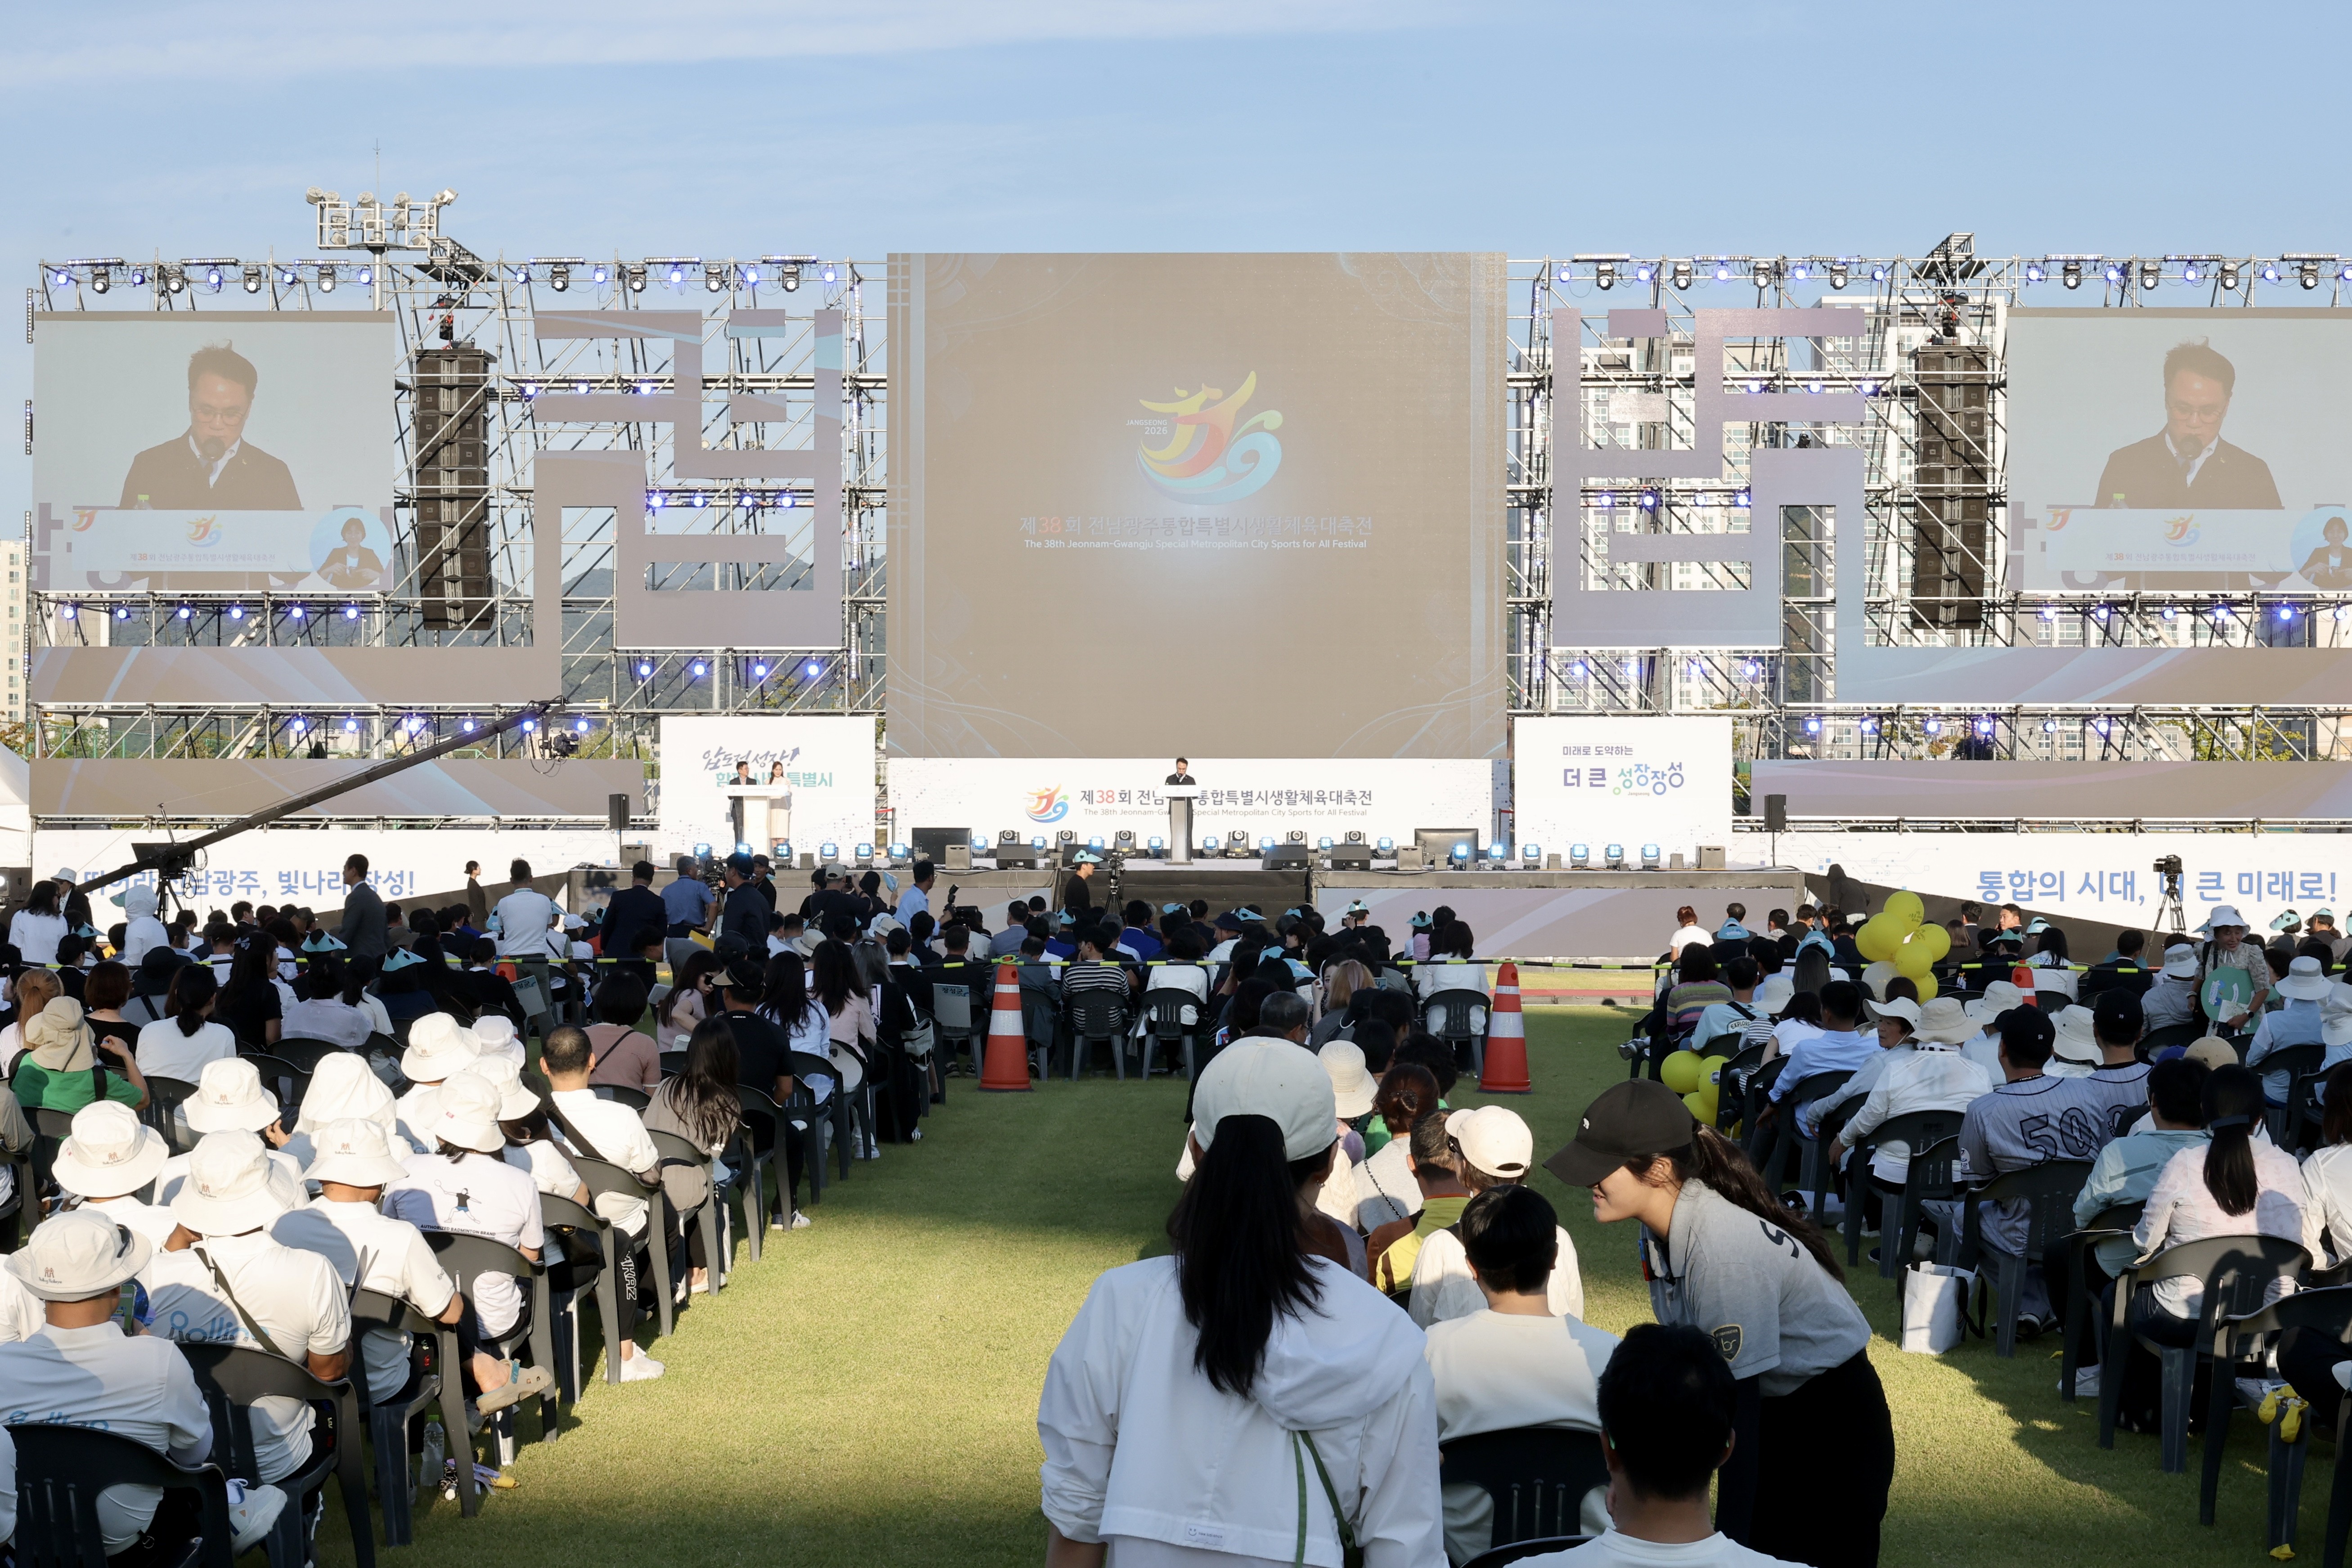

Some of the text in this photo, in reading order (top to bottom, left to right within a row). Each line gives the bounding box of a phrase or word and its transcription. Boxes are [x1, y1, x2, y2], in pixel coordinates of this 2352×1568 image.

[1145, 427, 1168, 435] 2026
[1024, 539, 1367, 550] The 38th Jeonnam-Gwangju Special Metropolitan City Sports for All Festival
[1562, 746, 1634, 756] 미래로 도약하는
[1563, 768, 1581, 787] 더
[1588, 768, 1607, 787] 큰
[1221, 809, 1269, 818] Metropolitan
[1271, 809, 1286, 818] City
[1288, 809, 1312, 818] Sports
[1976, 870, 2065, 903] 통합의
[2077, 870, 2145, 906] 시대,
[2195, 872, 2225, 901] 큰
[2237, 871, 2336, 902] 미래로!
[2020, 1106, 2094, 1167] 50
[420, 1223, 450, 1231] AUTHORIZED
